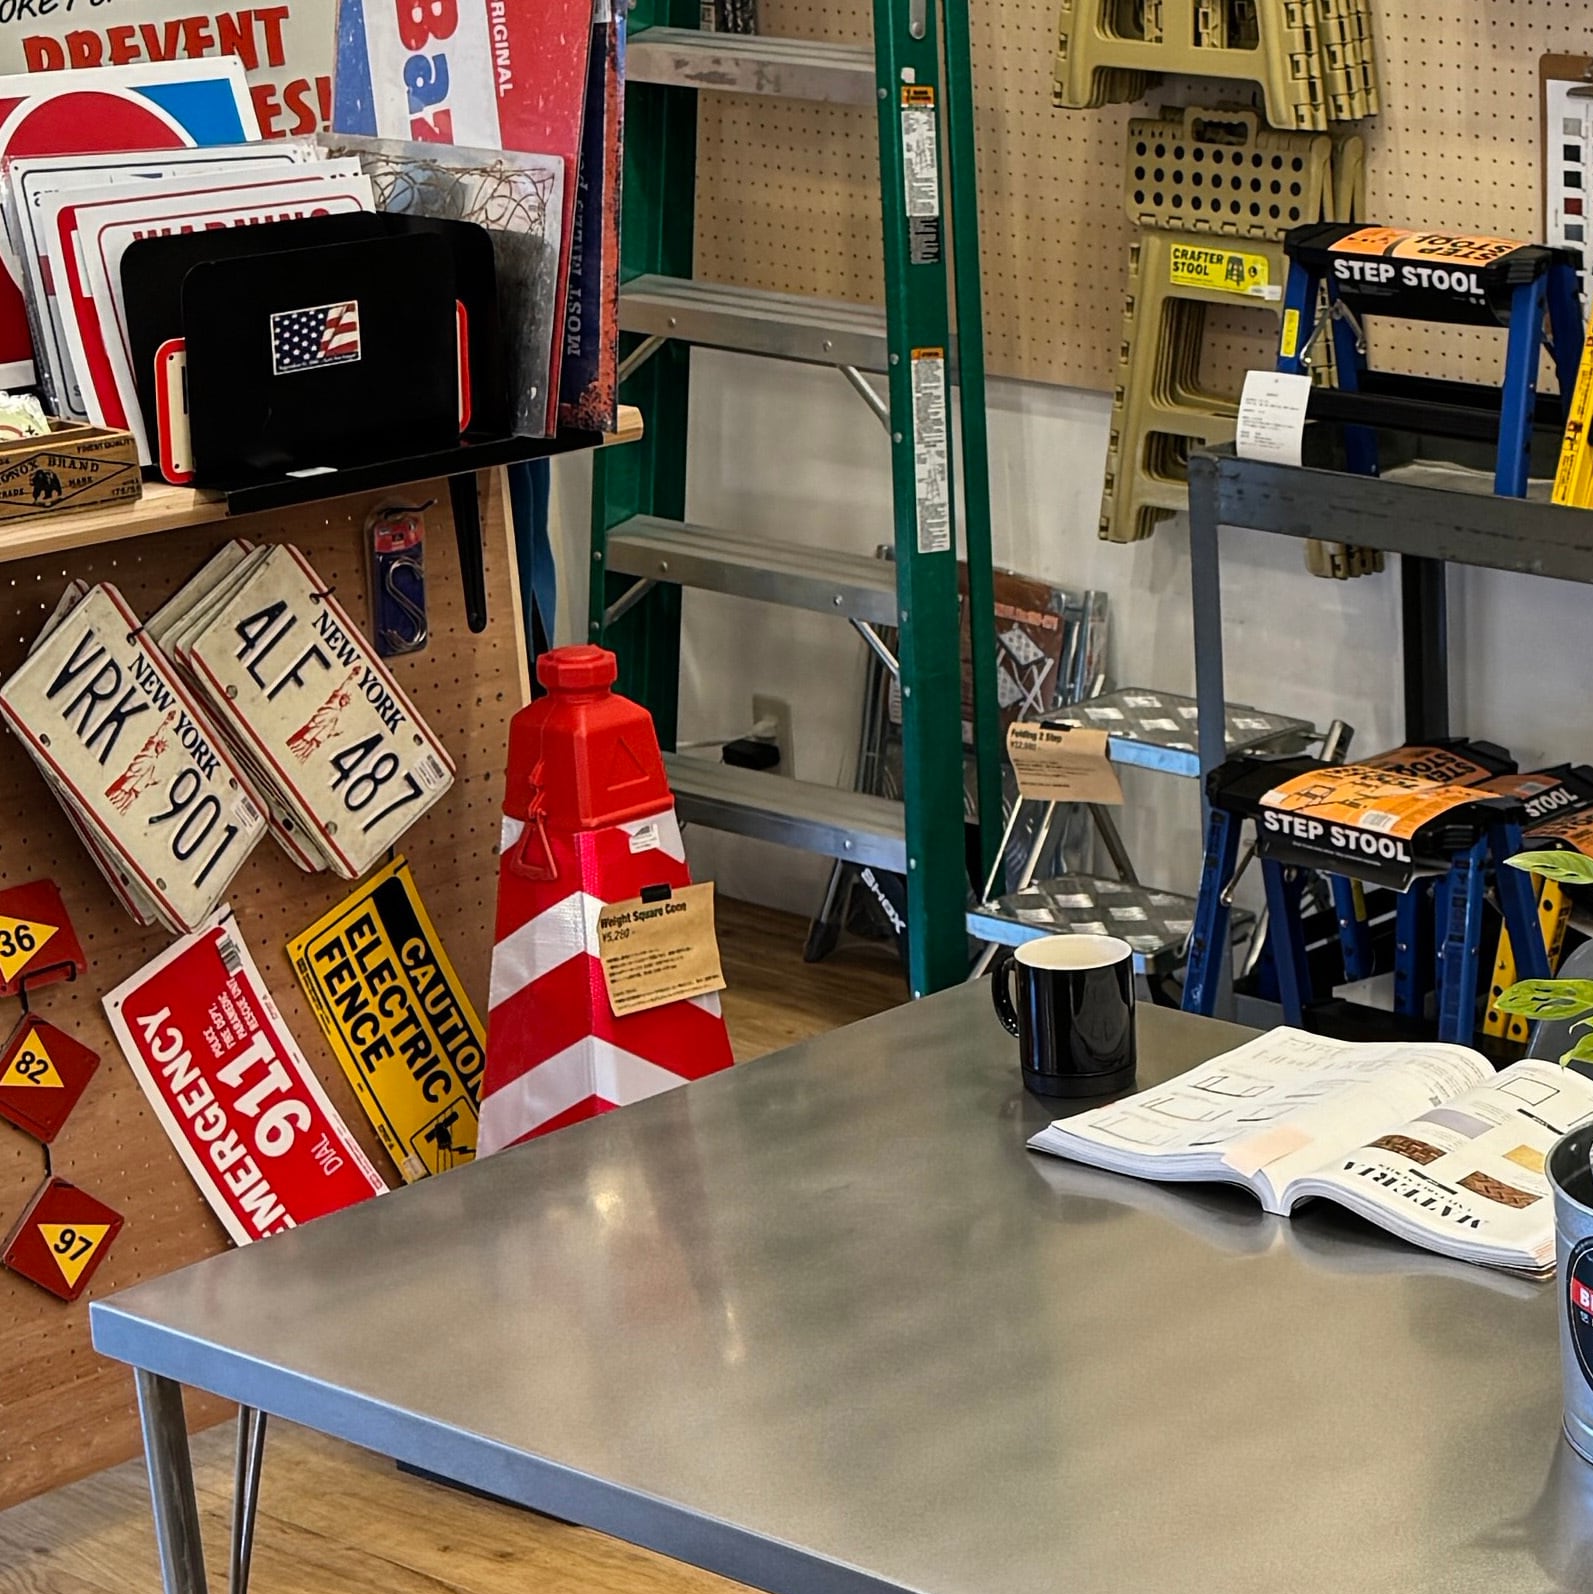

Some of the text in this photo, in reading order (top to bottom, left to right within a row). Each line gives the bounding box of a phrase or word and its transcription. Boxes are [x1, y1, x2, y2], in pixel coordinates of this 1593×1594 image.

[22, 6, 289, 73] PREVENT
[249, 76, 332, 140] ES!
[1172, 261, 1209, 276] STOOL
[1173, 248, 1224, 264] CRAFTER
[1415, 234, 1513, 255] STOOL
[1418, 247, 1498, 261] STEP
[1334, 258, 1485, 295] STEP STOOL
[47, 457, 99, 473] BRAND
[234, 600, 332, 702] 4LF
[312, 609, 407, 735] NEW YORK
[46, 628, 150, 767] VRK
[127, 653, 221, 782] NEW YORK
[331, 733, 425, 835] 487
[1524, 787, 1579, 818] STOOL
[148, 768, 239, 889] 901
[1264, 811, 1324, 840] STEP
[1331, 826, 1411, 864] STOOL
[0, 923, 36, 959] 36
[601, 914, 632, 929] Weight
[633, 906, 663, 922] Square
[314, 935, 395, 1074] FENCE
[345, 912, 452, 1104] ELECTRIC
[15, 1050, 49, 1085] 82
[215, 1029, 313, 1158] 911
[311, 1132, 344, 1177] DIAL
[53, 1228, 93, 1263] 97
